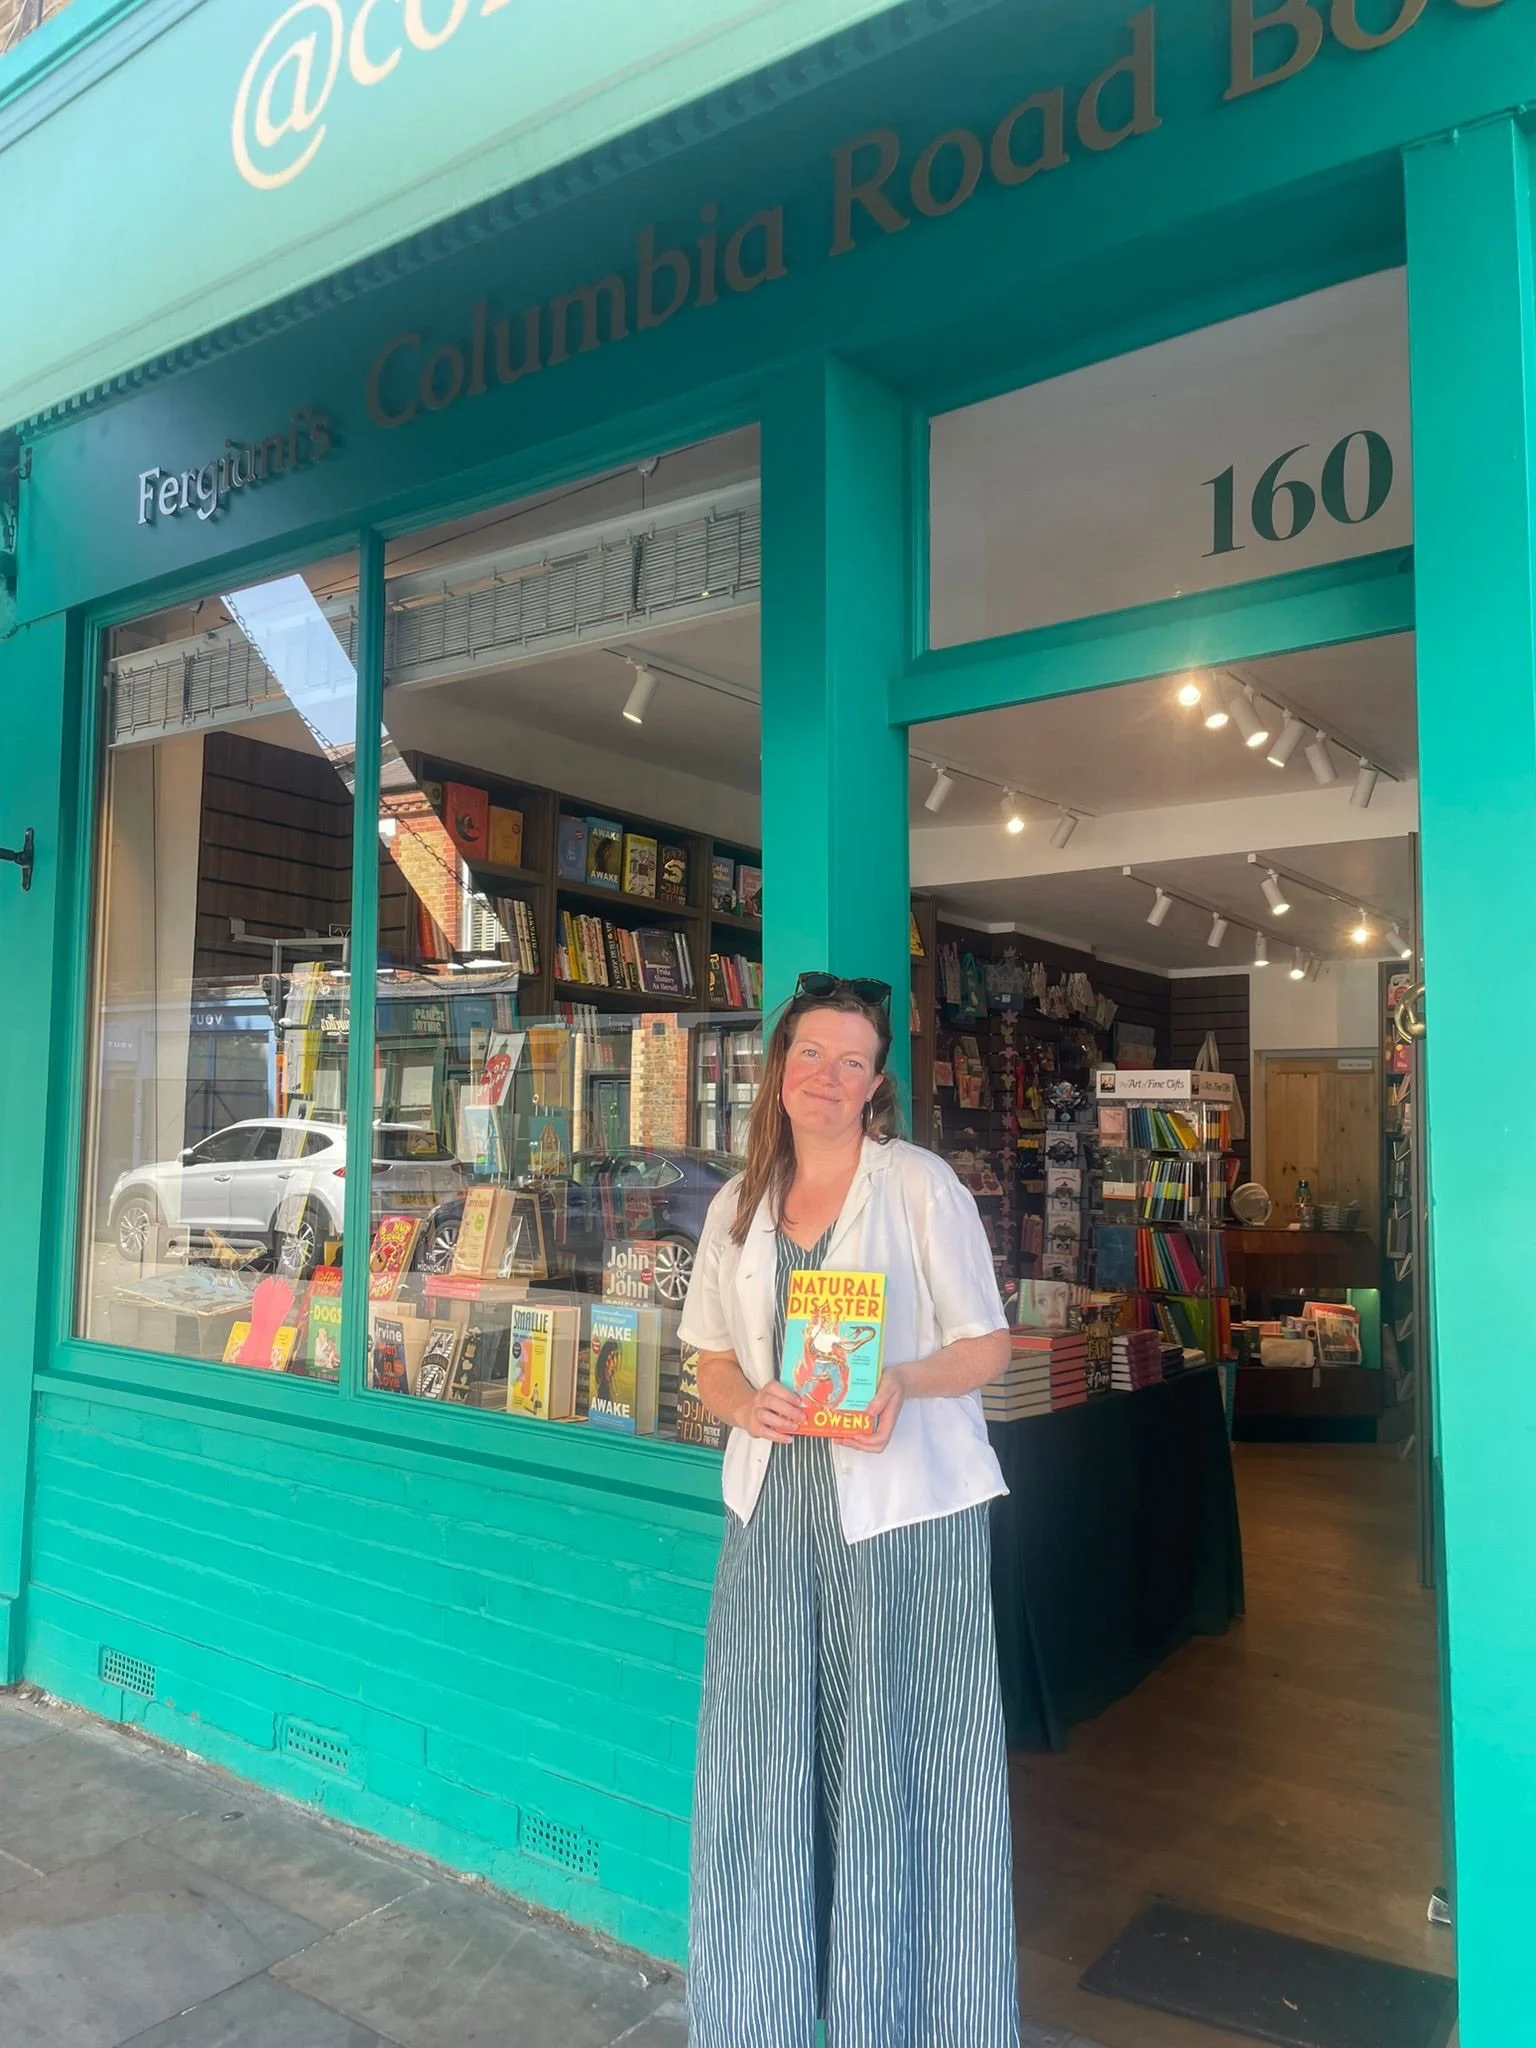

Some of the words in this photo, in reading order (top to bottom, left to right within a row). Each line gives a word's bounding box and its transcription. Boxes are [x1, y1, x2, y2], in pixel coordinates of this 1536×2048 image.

[366, 203, 787, 427] Columbia
[830, 6, 1161, 256] Road
[1200, 429, 1394, 558] 160
[592, 828, 622, 841] AWAKE
[590, 870, 620, 884] AWAKE
[1128, 1079, 1141, 1089] Art
[1147, 1079, 1165, 1089] Fine
[1166, 1079, 1185, 1091] Gifts
[425, 1252, 437, 1261] THE
[607, 1246, 649, 1269] John
[417, 1264, 445, 1273] MIDNIGHT
[606, 1273, 648, 1299] John
[792, 1276, 881, 1298] NATURAL
[313, 1305, 342, 1323] DOGS
[790, 1296, 879, 1318] DISASTER
[513, 1310, 549, 1334] SMALLIE
[376, 1324, 402, 1342] Irvine
[592, 1323, 632, 1341] AWAKE
[380, 1376, 401, 1388] Love
[590, 1397, 630, 1418] AWAKE
[814, 1411, 871, 1429] OWENS
[677, 1420, 703, 1442] FIELD
